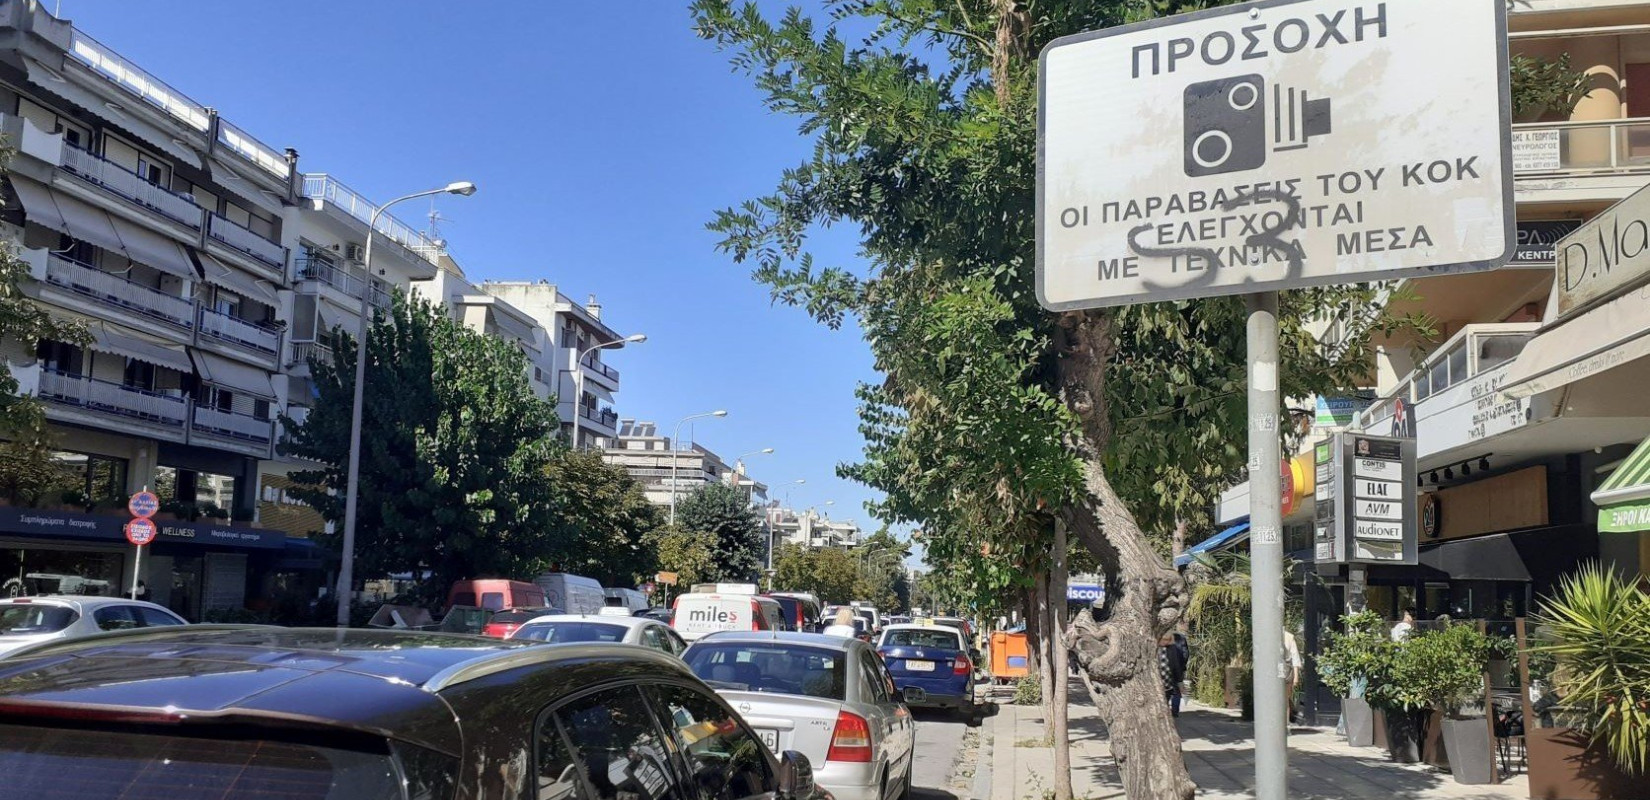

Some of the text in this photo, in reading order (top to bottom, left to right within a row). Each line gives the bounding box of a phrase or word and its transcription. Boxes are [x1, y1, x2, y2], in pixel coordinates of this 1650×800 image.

[1131, 3, 1387, 79] ΠΡΟΣΟΧΗ
[1060, 155, 1480, 228] ΟΙ ΠΑΡΑΒΑΣΕΙΣ ΤΟΥ ΚΟΚ
[1157, 201, 1363, 245] ΕΛΕΓΧΟΝΤΑΙ
[1097, 256, 1140, 281] ΜΕ
[1336, 225, 1434, 256] ΜΕΣΑ
[1365, 503, 1390, 514] AVM
[162, 526, 196, 538] WELLNESS
[1066, 587, 1105, 600] iscou
[689, 606, 738, 623] miles
